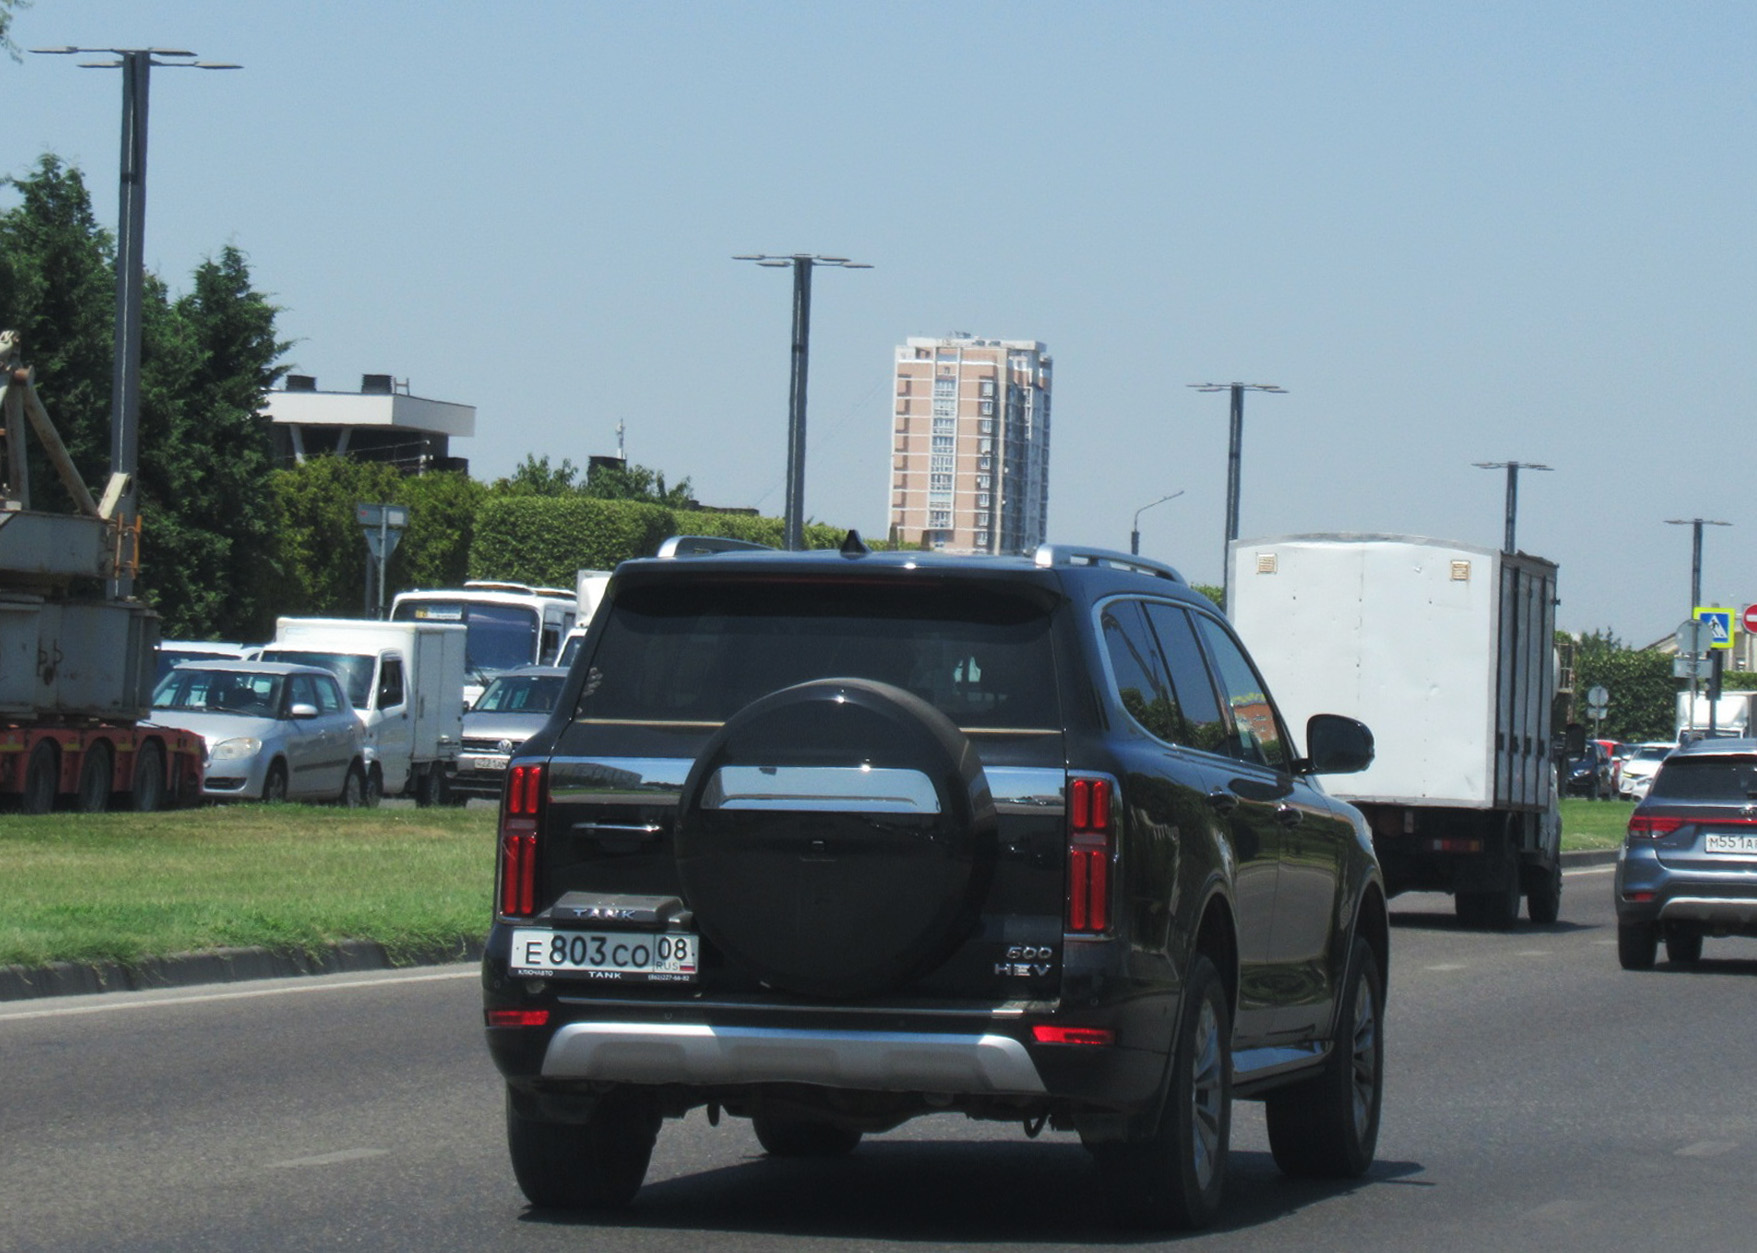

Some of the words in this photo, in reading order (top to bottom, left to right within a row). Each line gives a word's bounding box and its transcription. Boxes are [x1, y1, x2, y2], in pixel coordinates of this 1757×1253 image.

[573, 908, 636, 920] TANK
[657, 937, 688, 961] 08
[1006, 946, 1053, 960] 500
[656, 960, 679, 971] RUS
[994, 963, 1051, 977] HEV
[588, 970, 622, 980] TANK
